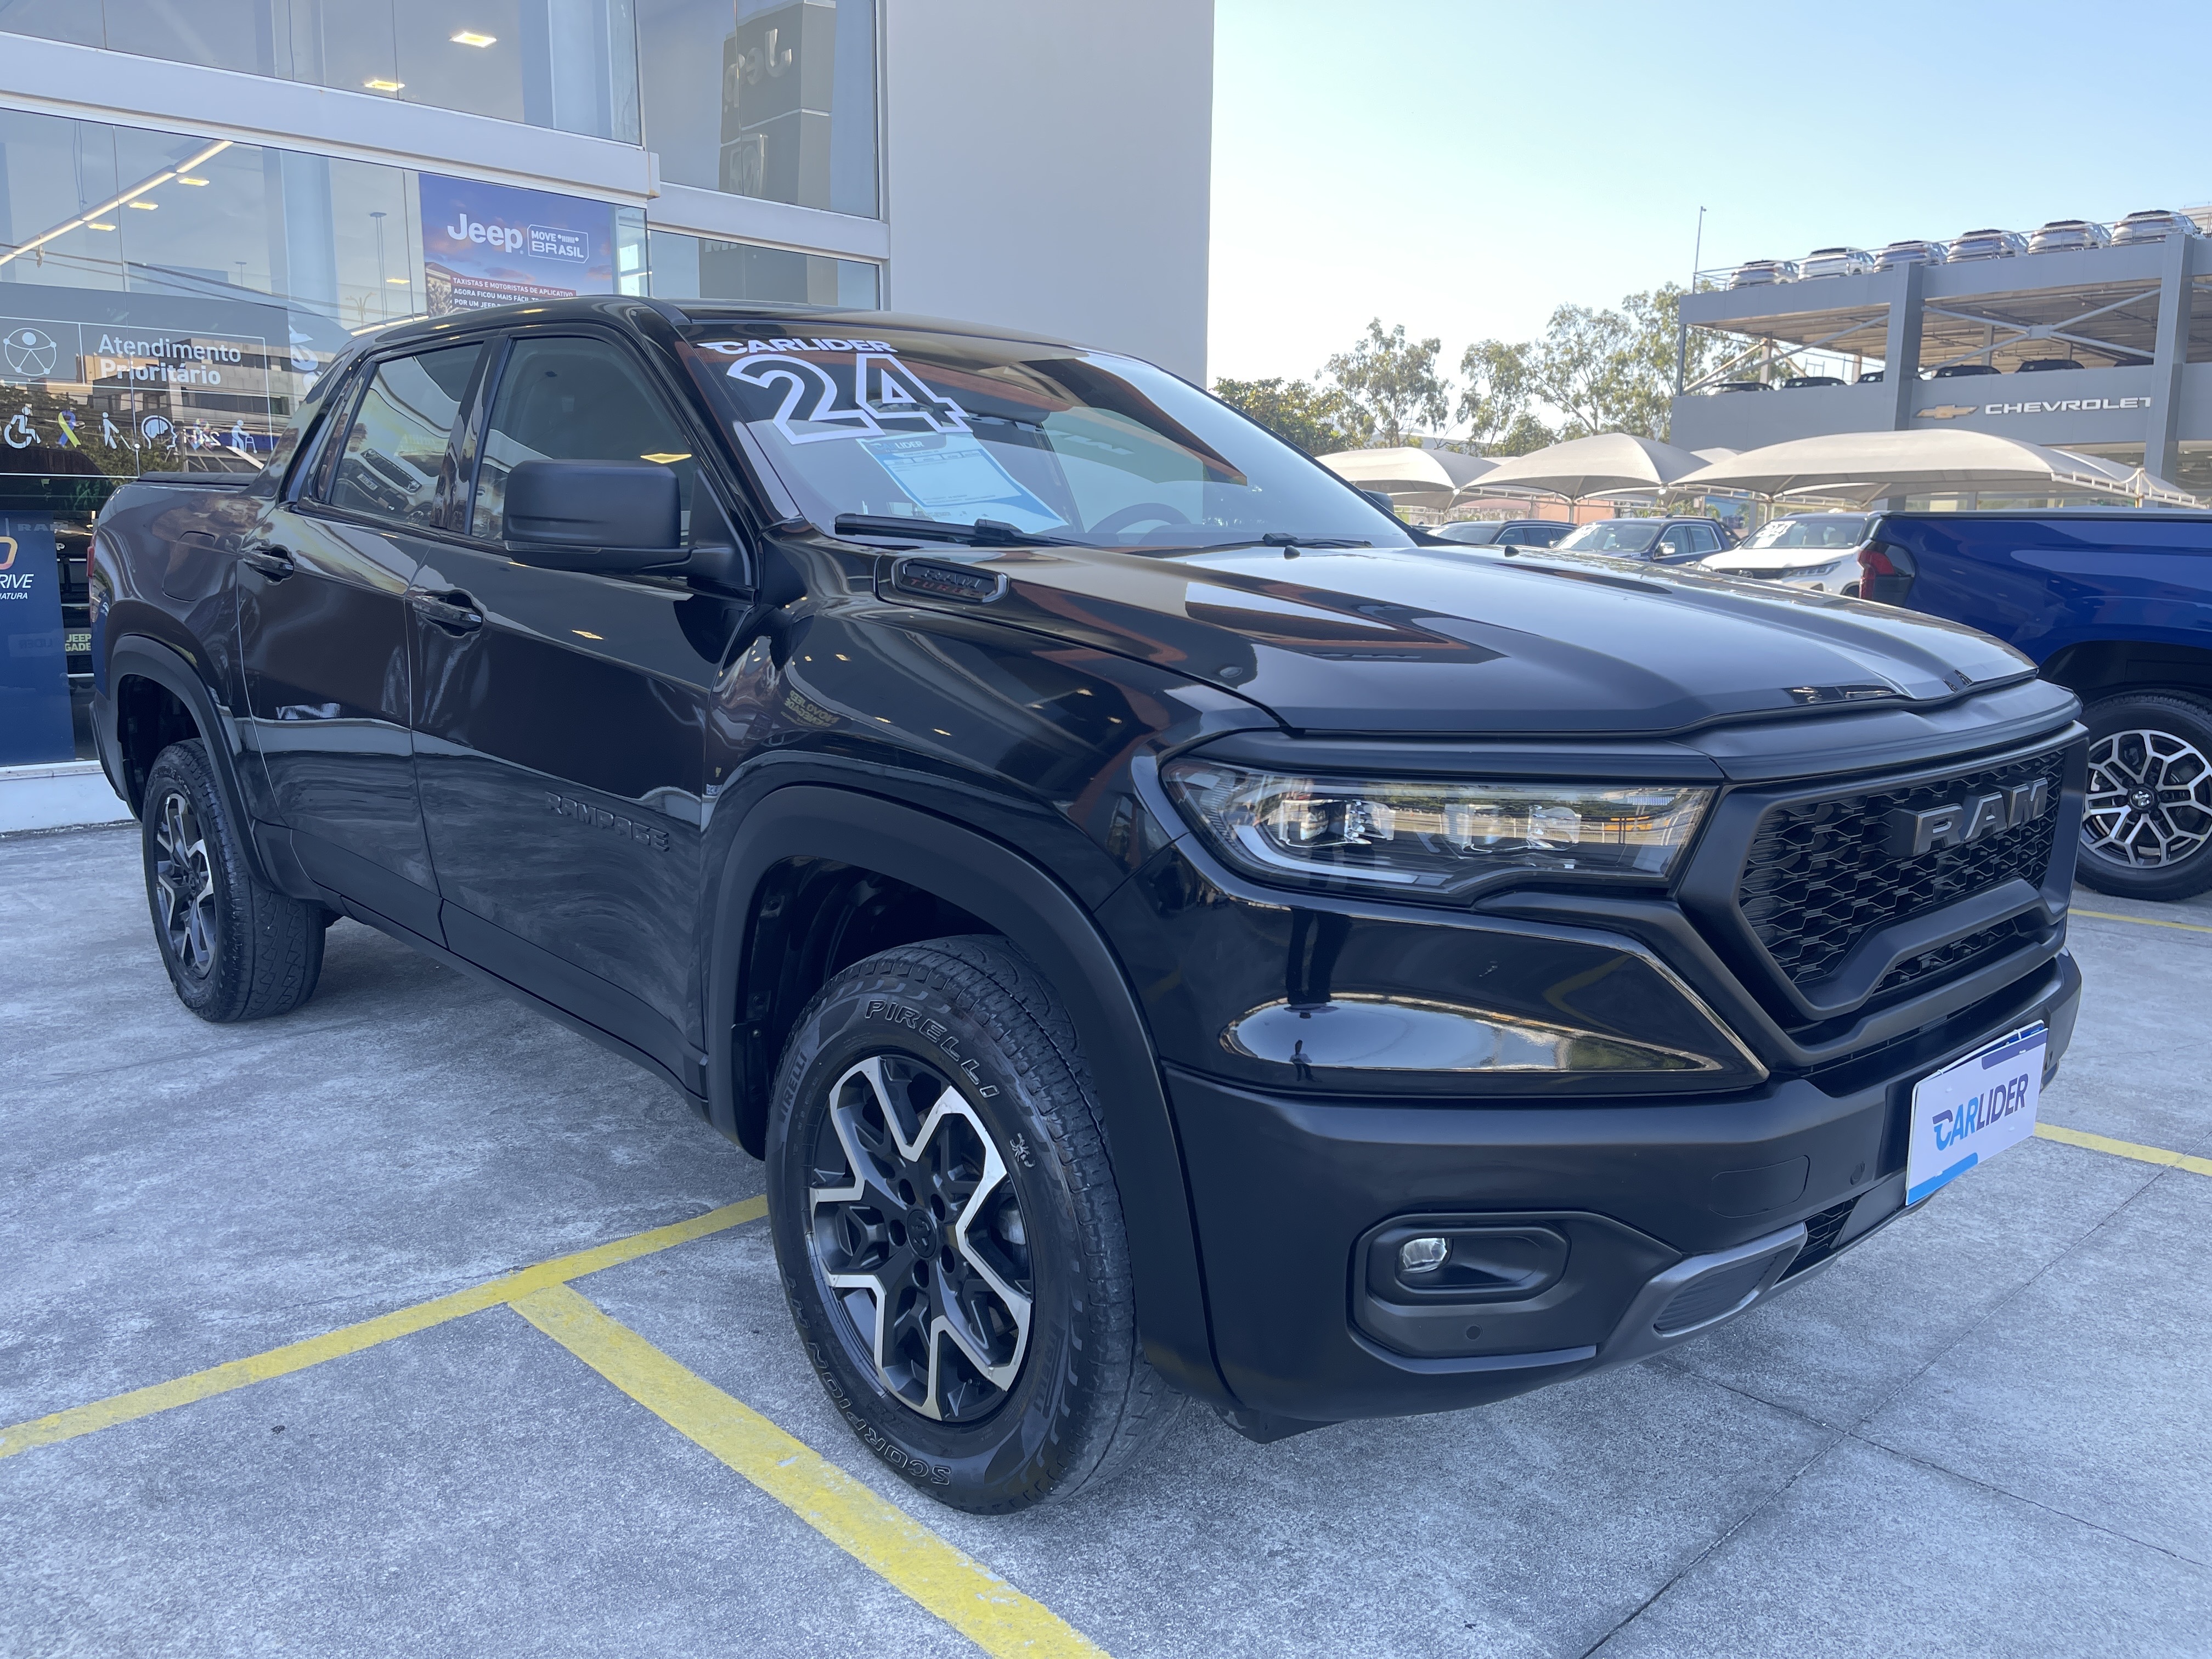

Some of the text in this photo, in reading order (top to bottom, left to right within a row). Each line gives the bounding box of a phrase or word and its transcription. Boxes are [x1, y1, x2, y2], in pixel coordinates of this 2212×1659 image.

[447, 213, 523, 253] Jeep
[531, 230, 556, 242] MOVE
[532, 241, 584, 258] BRASIL
[453, 277, 483, 287] TAXISTAS
[490, 282, 528, 292] MOTORISTAS
[98, 334, 241, 363] Atendimento
[697, 338, 898, 354] CARLIDER
[100, 359, 221, 385] Prioritário
[726, 353, 973, 445] 24
[545, 792, 670, 851] RAMPAGE
[1913, 777, 2048, 855] RAM
[865, 1000, 1000, 1099] PIRELLI
[1932, 1074, 2028, 1151] CARLIDER
[806, 1342, 951, 1485] SCORPION
